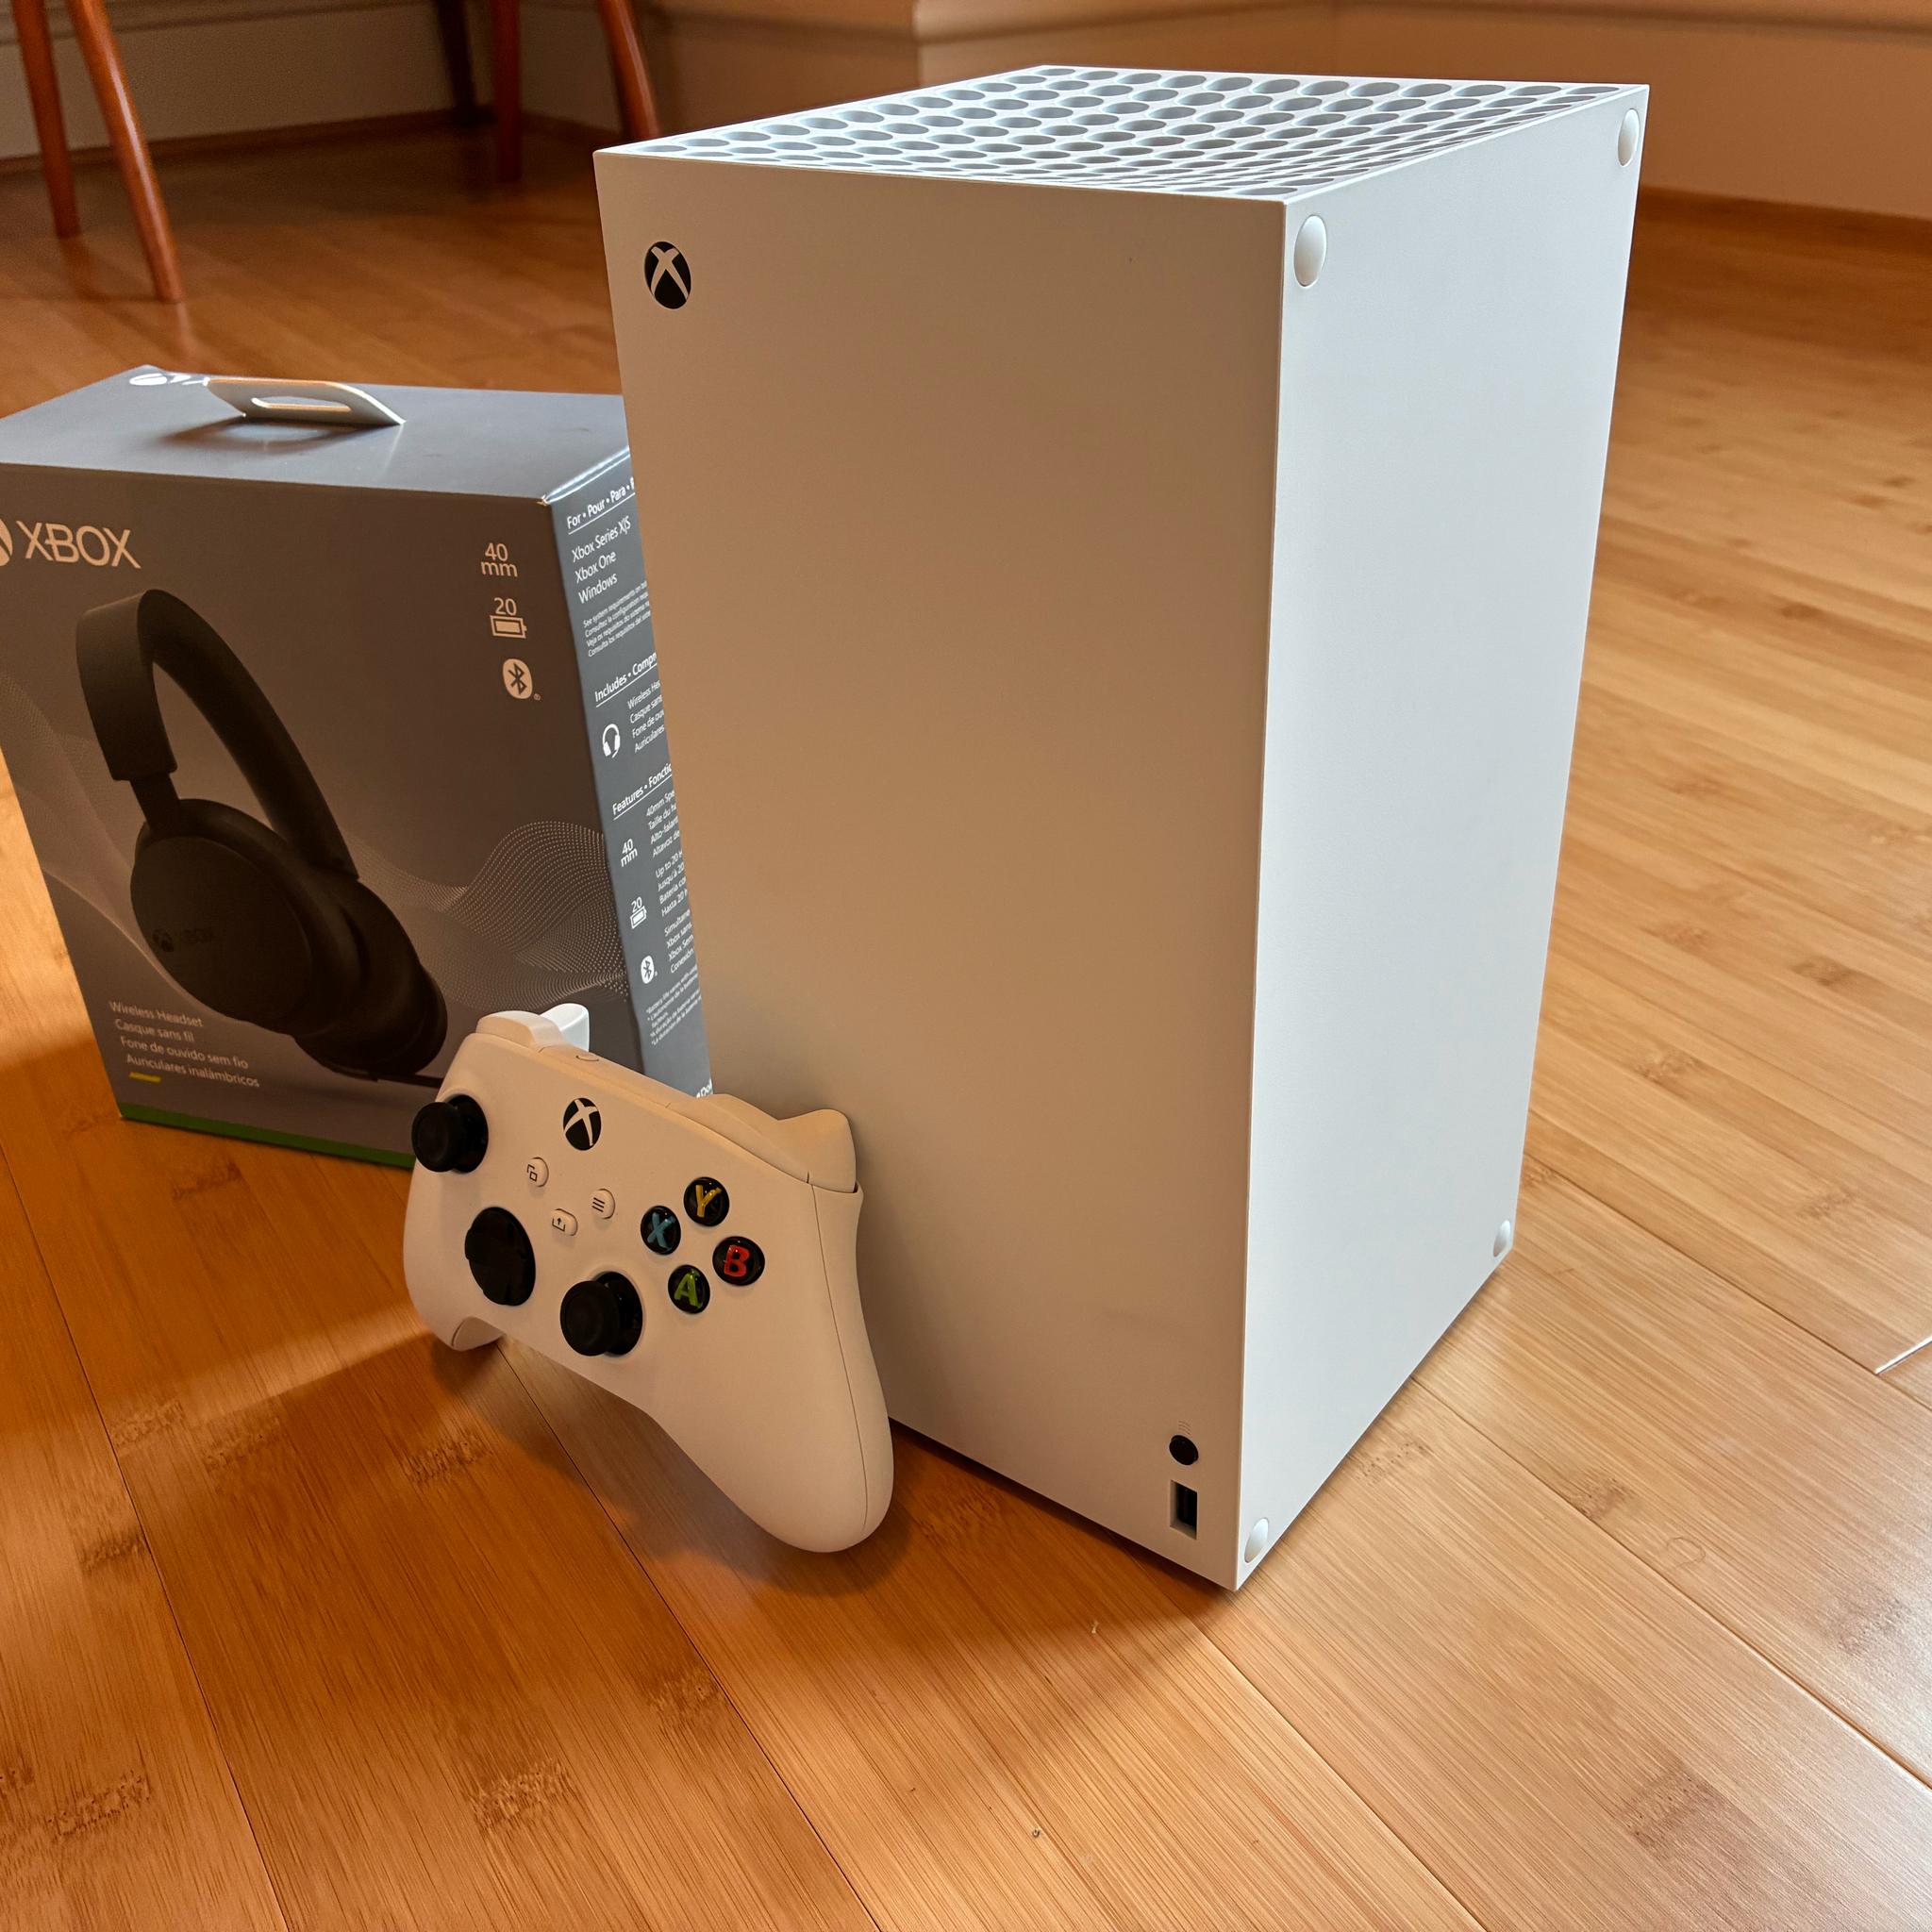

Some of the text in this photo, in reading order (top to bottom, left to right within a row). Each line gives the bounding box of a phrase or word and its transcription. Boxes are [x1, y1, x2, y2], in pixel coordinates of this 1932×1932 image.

[567, 486, 626, 529] For Pour Para
[16, 520, 142, 569] XBOX
[485, 542, 508, 561] 40
[572, 541, 594, 562] Xbox
[595, 526, 619, 549] Series
[481, 560, 518, 577] mm
[575, 552, 616, 584] Xbox One
[578, 574, 617, 604] Windows
[493, 597, 518, 616] 20
[595, 675, 627, 702] Includes
[613, 787, 643, 815] Features
[621, 848, 638, 867] mm
[623, 839, 633, 855] 40
[632, 896, 641, 911] 20
[109, 1001, 203, 1027] Wireless Headset
[115, 1018, 194, 1042] Casque sans fil
[121, 1036, 248, 1069] Fone de ouvido sem fio
[126, 1054, 259, 1088] Auriculares inalámbricos
[695, 1185, 722, 1217] Y
[647, 1212, 675, 1249] X
[724, 1244, 750, 1277] B
[674, 1272, 703, 1308] A
